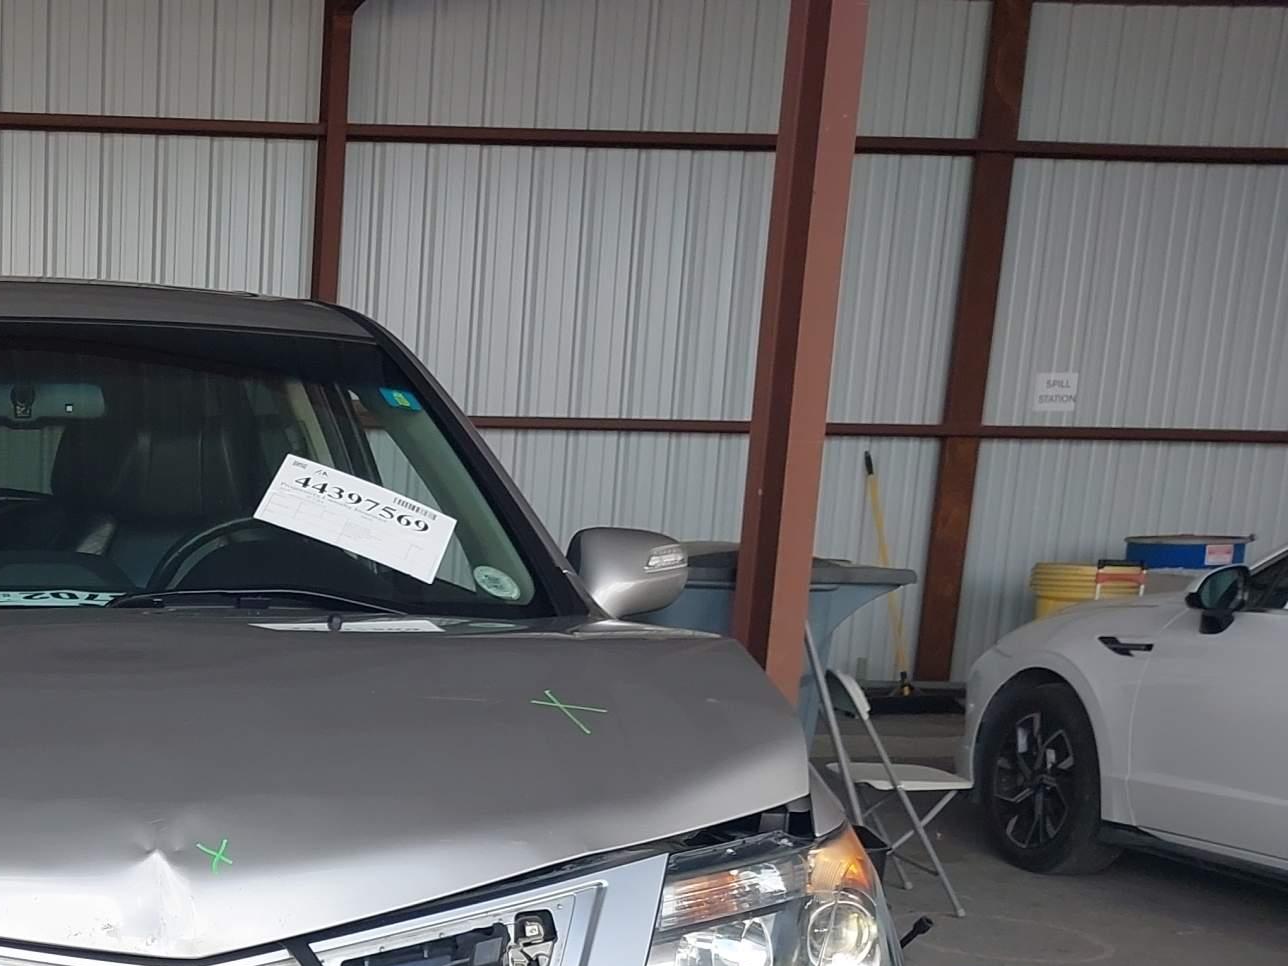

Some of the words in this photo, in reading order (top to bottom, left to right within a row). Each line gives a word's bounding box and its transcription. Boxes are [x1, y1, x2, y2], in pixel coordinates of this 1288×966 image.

[1046, 379, 1071, 388] SPILL
[1038, 394, 1076, 404] STATION
[294, 476, 430, 532] 44397569
